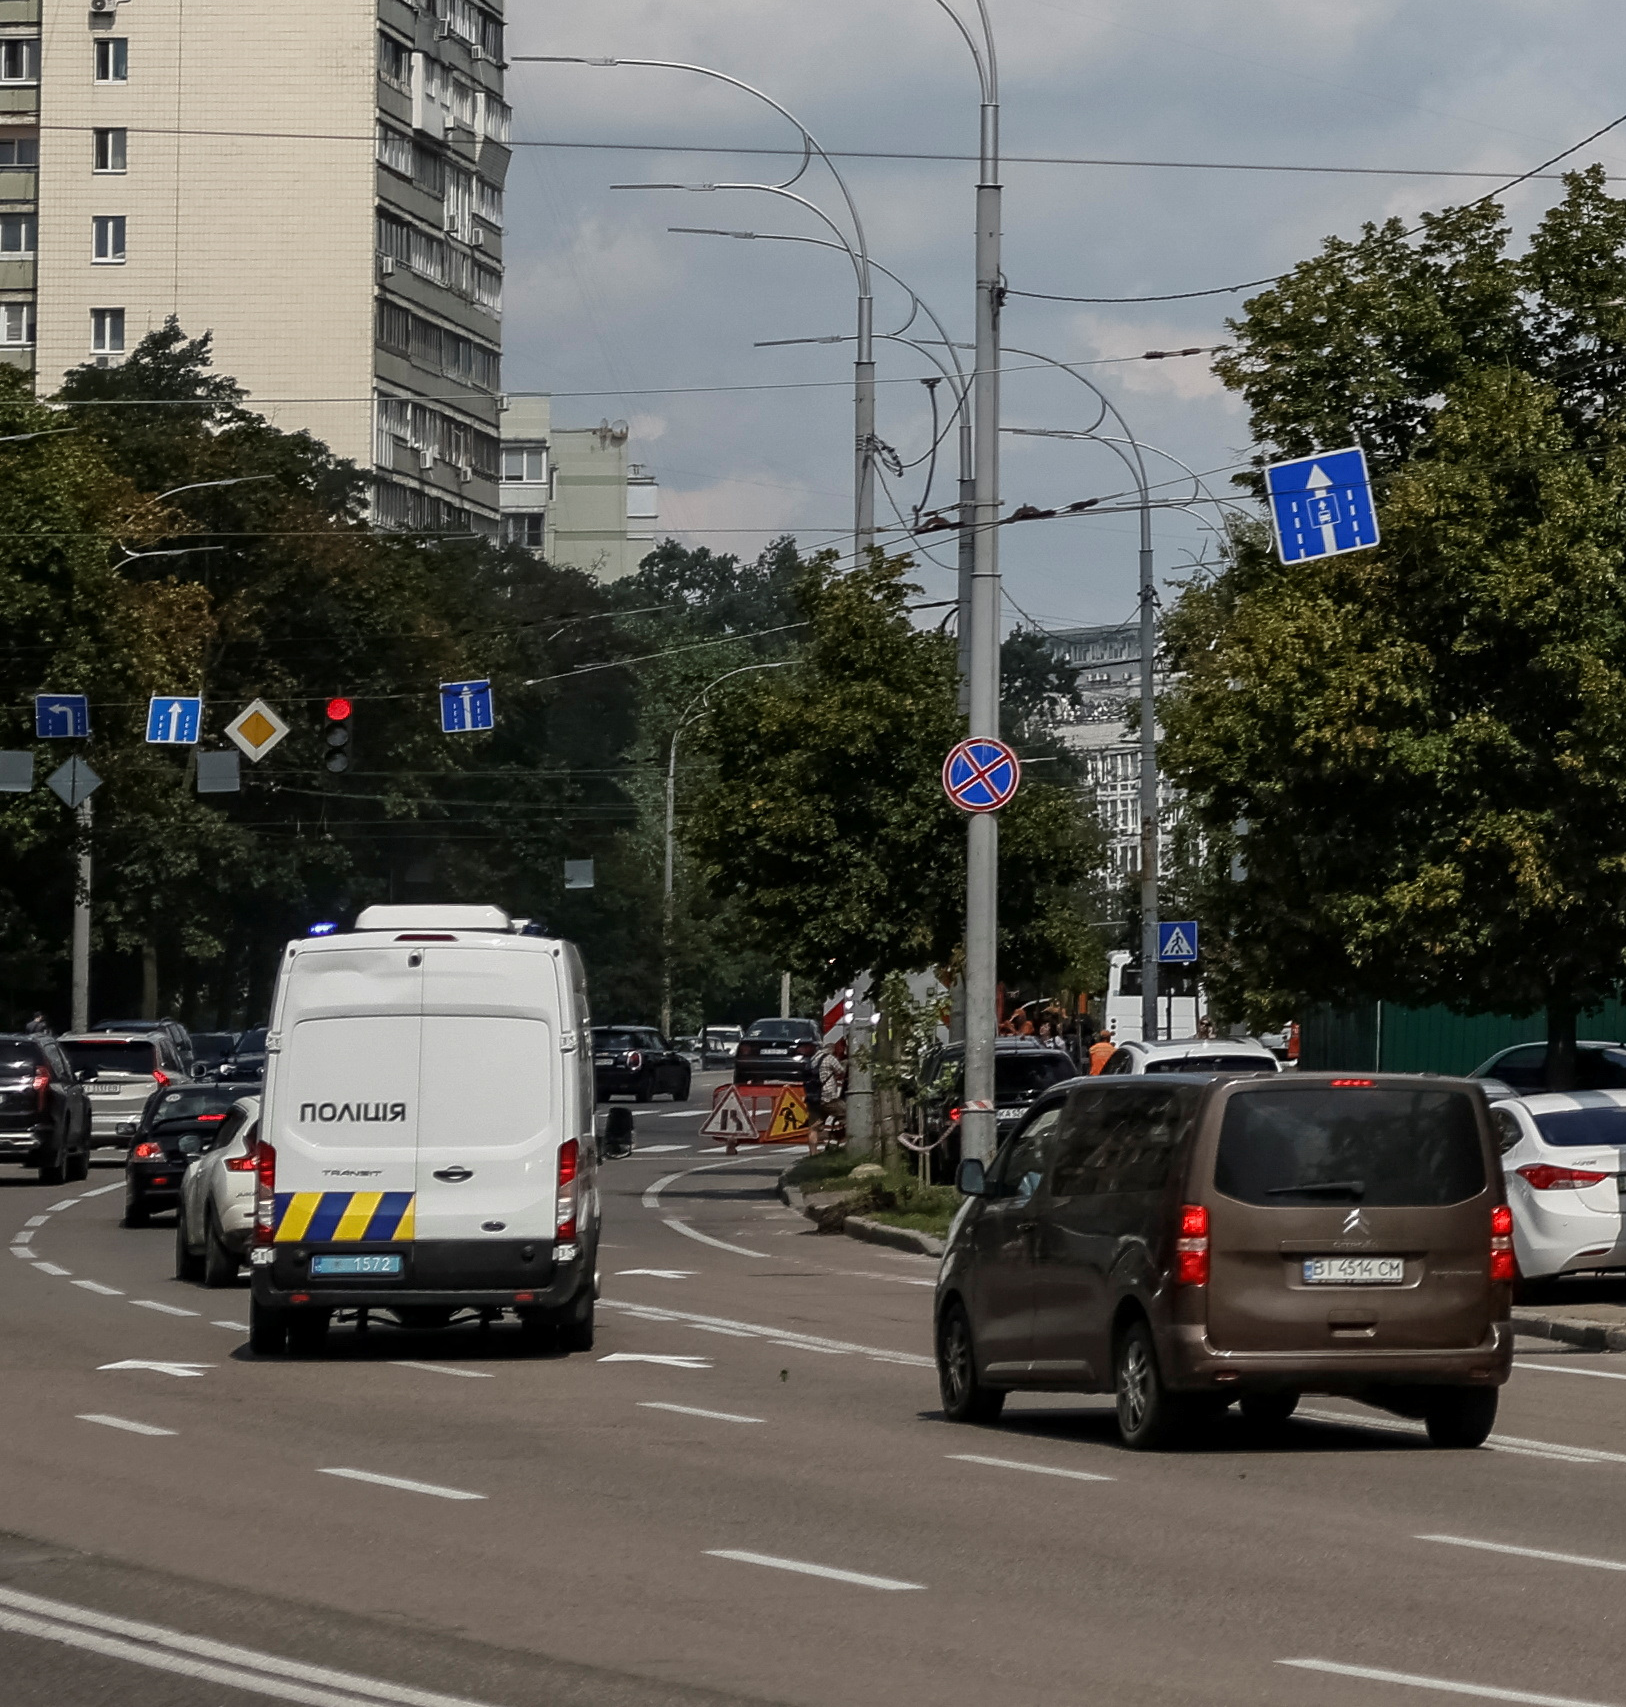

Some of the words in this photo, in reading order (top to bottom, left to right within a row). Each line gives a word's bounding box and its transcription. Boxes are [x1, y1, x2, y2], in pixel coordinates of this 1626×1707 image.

[300, 1102, 406, 1122] ПОЛІЦІЯ
[354, 1257, 391, 1272] 1572
[1313, 1260, 1332, 1276] BI
[1338, 1259, 1373, 1276] 4514
[1378, 1260, 1401, 1276] CM
